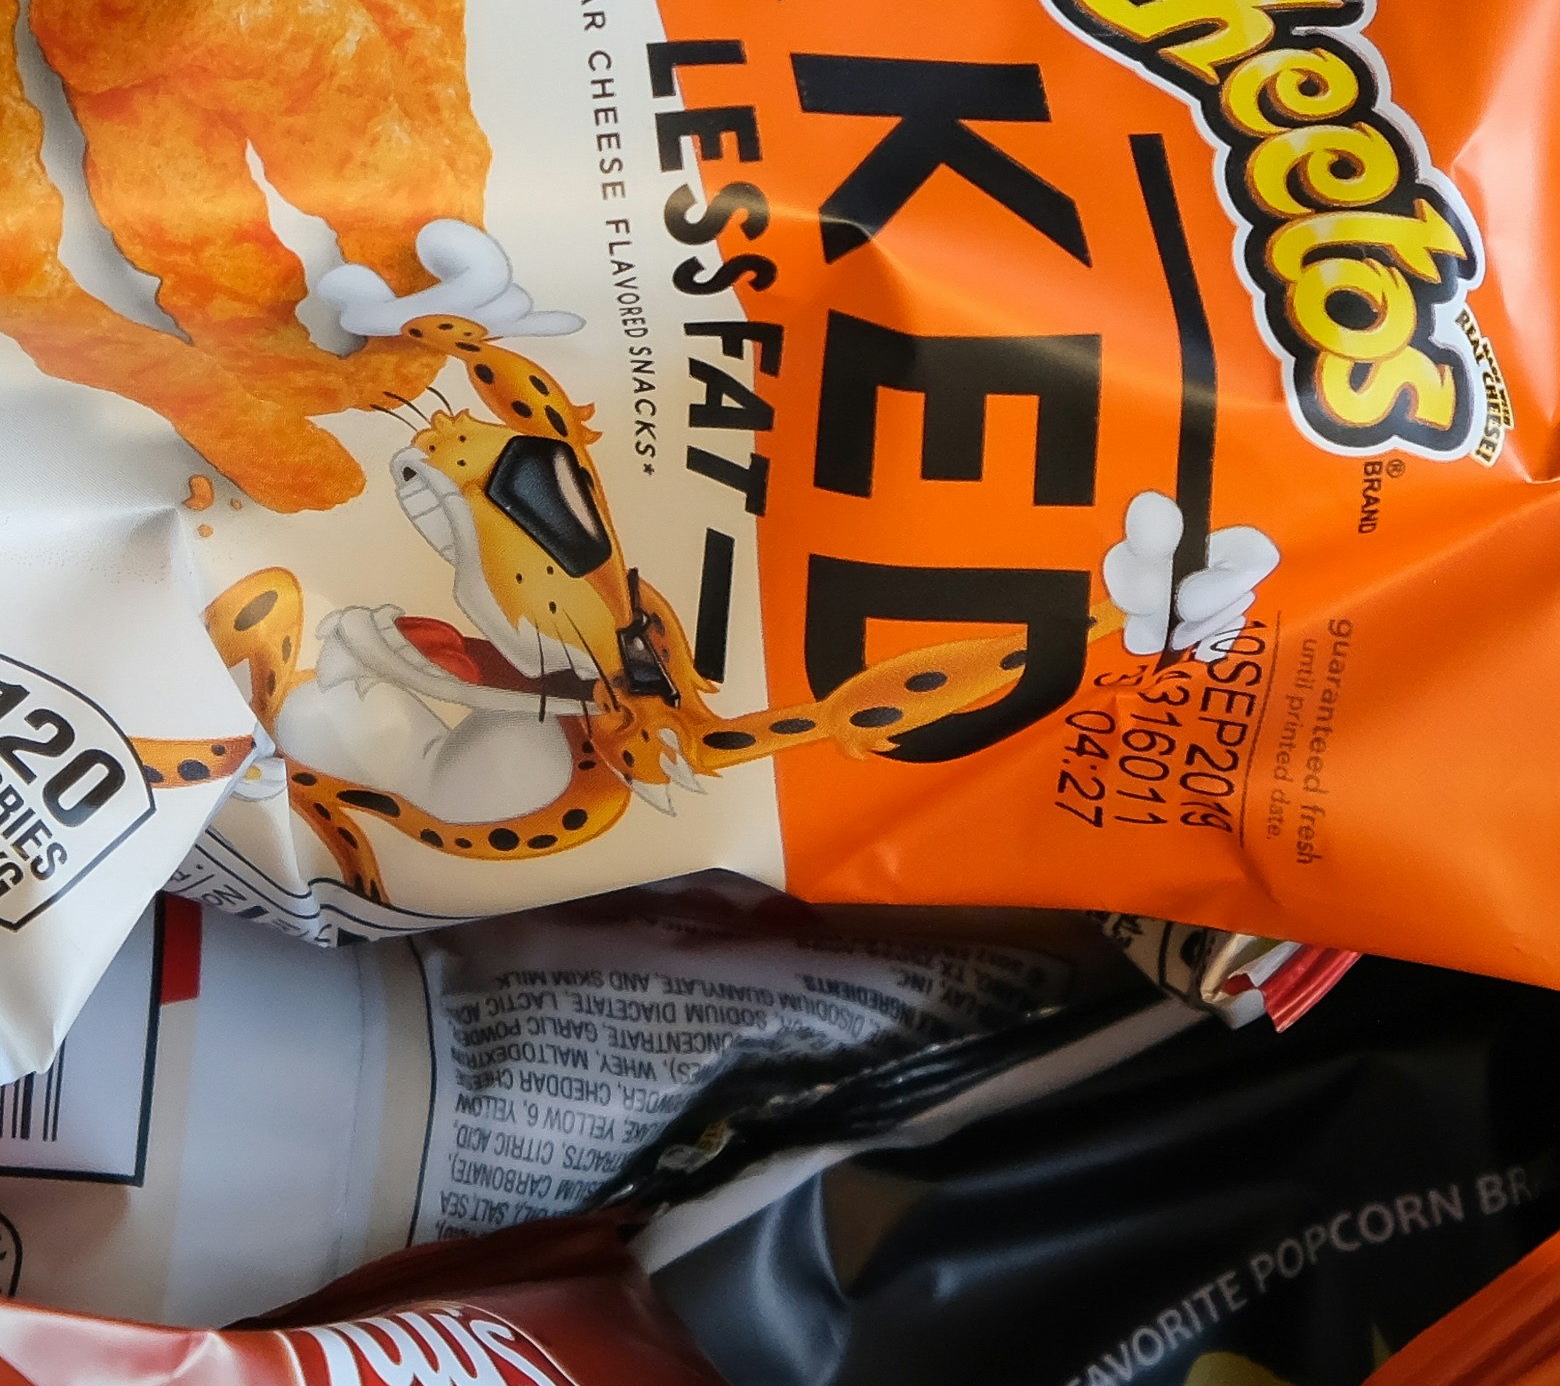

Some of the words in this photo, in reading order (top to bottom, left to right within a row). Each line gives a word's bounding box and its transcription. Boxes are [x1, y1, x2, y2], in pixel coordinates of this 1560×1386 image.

[585, 51, 626, 200] CHEESE
[646, 39, 778, 296] LESS
[605, 218, 650, 341] FLAVORED
[682, 320, 783, 517] FAT
[1358, 461, 1382, 534] BRAND
[1295, 638, 1319, 691] until
[1303, 619, 1354, 796] guaranteed
[1271, 697, 1303, 794] printed
[1265, 789, 1288, 841] date.
[1296, 804, 1327, 865] fresh
[1250, 1184, 1464, 1294] POPCORN
